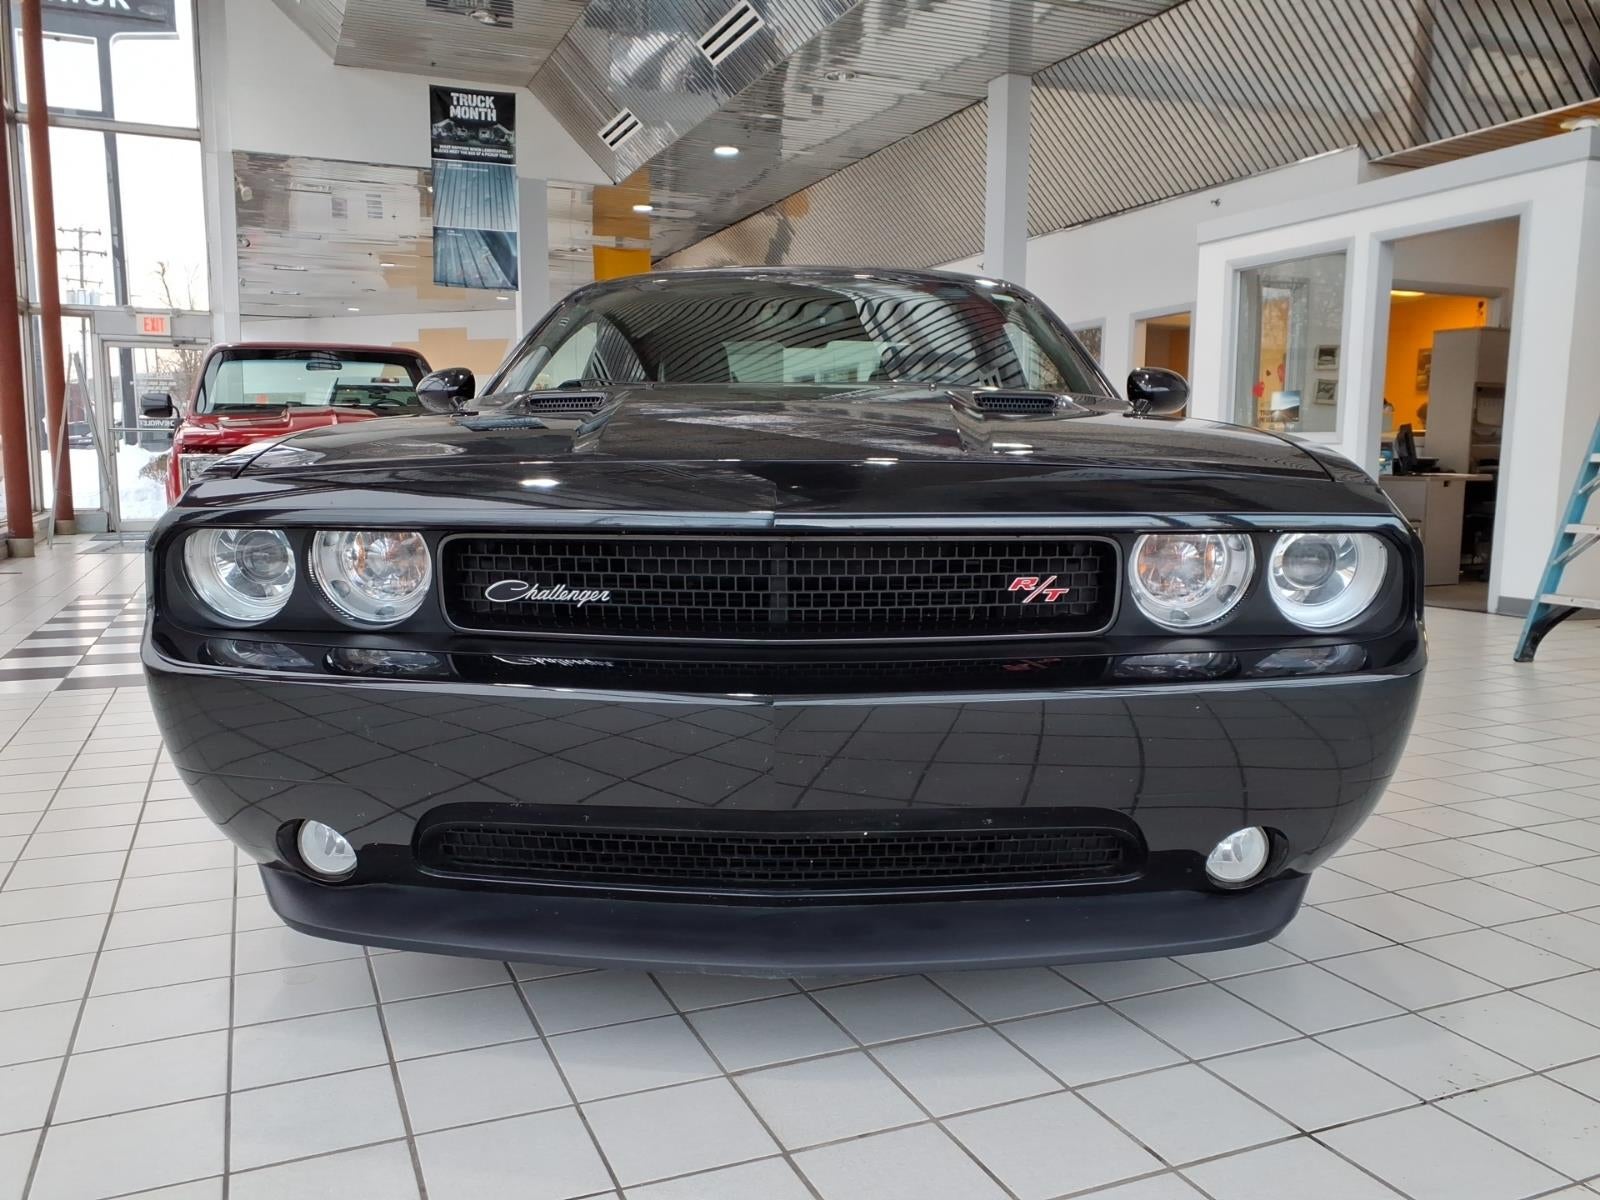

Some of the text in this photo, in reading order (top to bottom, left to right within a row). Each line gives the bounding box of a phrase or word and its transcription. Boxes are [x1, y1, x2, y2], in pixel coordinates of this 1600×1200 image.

[450, 92, 495, 109] TRUCK
[449, 105, 497, 122] MONTH
[143, 317, 165, 332] EXIT
[484, 579, 611, 608] Challenger
[1007, 575, 1070, 604] R/T
